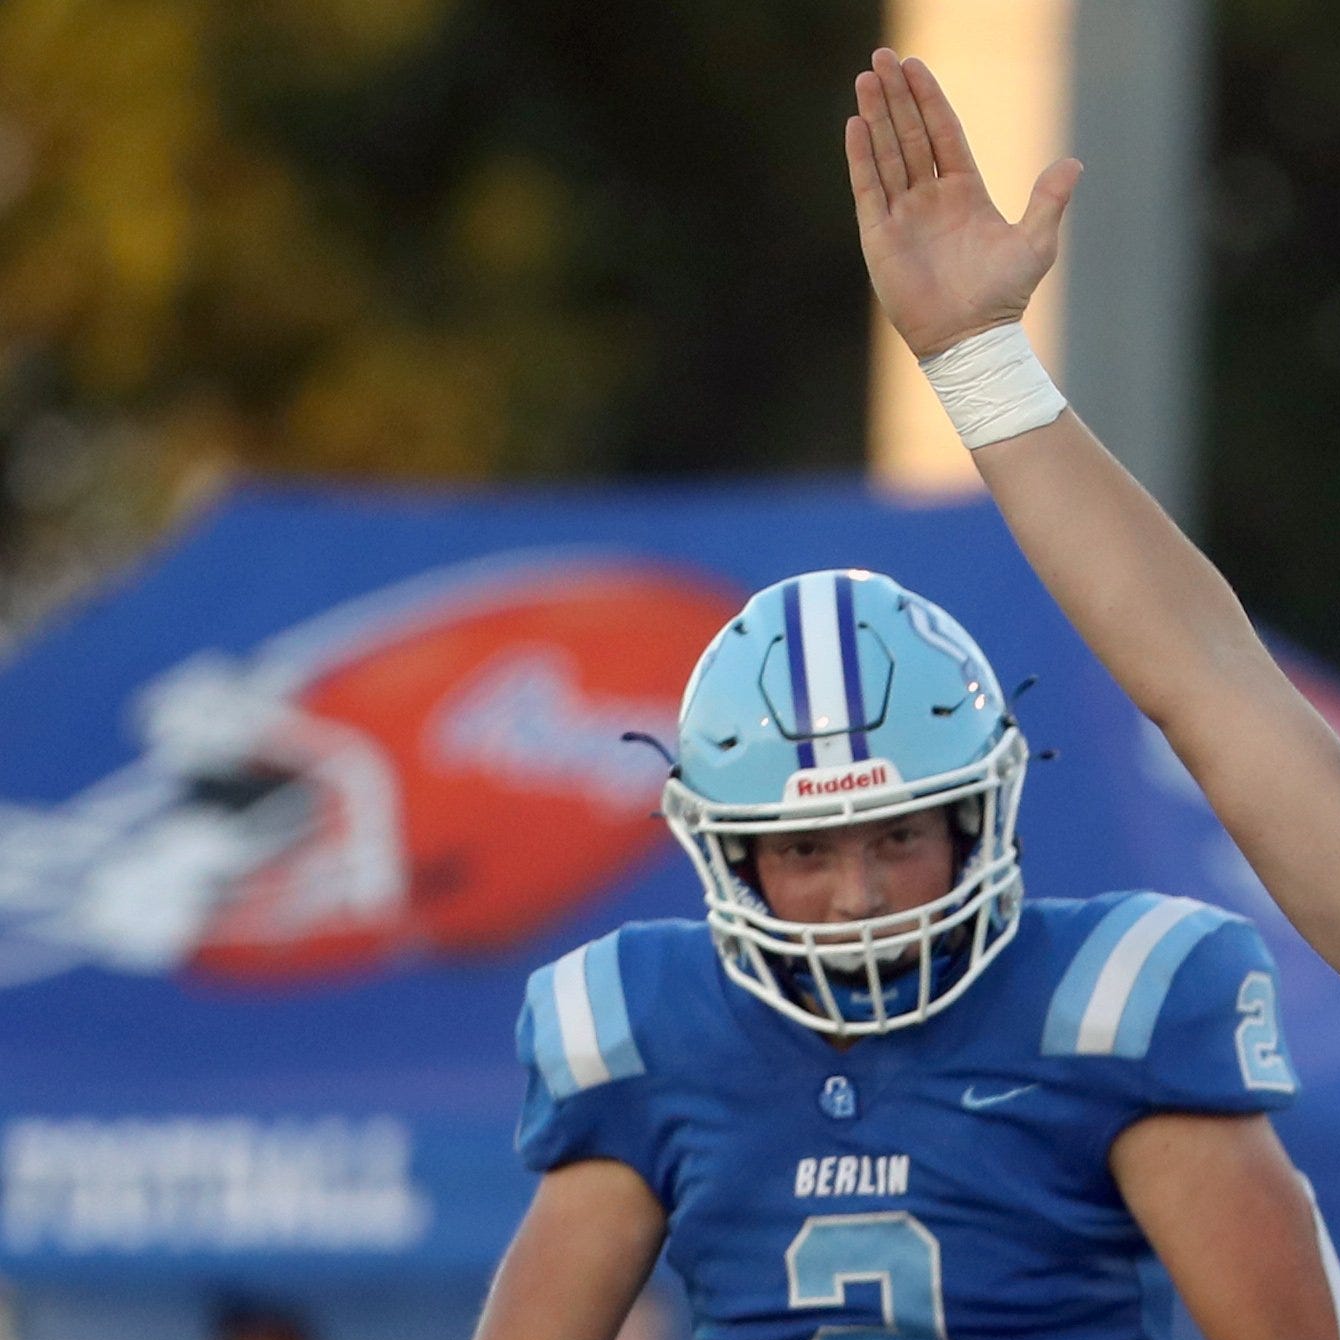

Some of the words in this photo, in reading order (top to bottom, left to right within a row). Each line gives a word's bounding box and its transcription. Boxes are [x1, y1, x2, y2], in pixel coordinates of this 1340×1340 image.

[797, 766, 887, 797] Riddell
[1235, 970, 1299, 1094] 2
[794, 1154, 910, 1198] BERLIN
